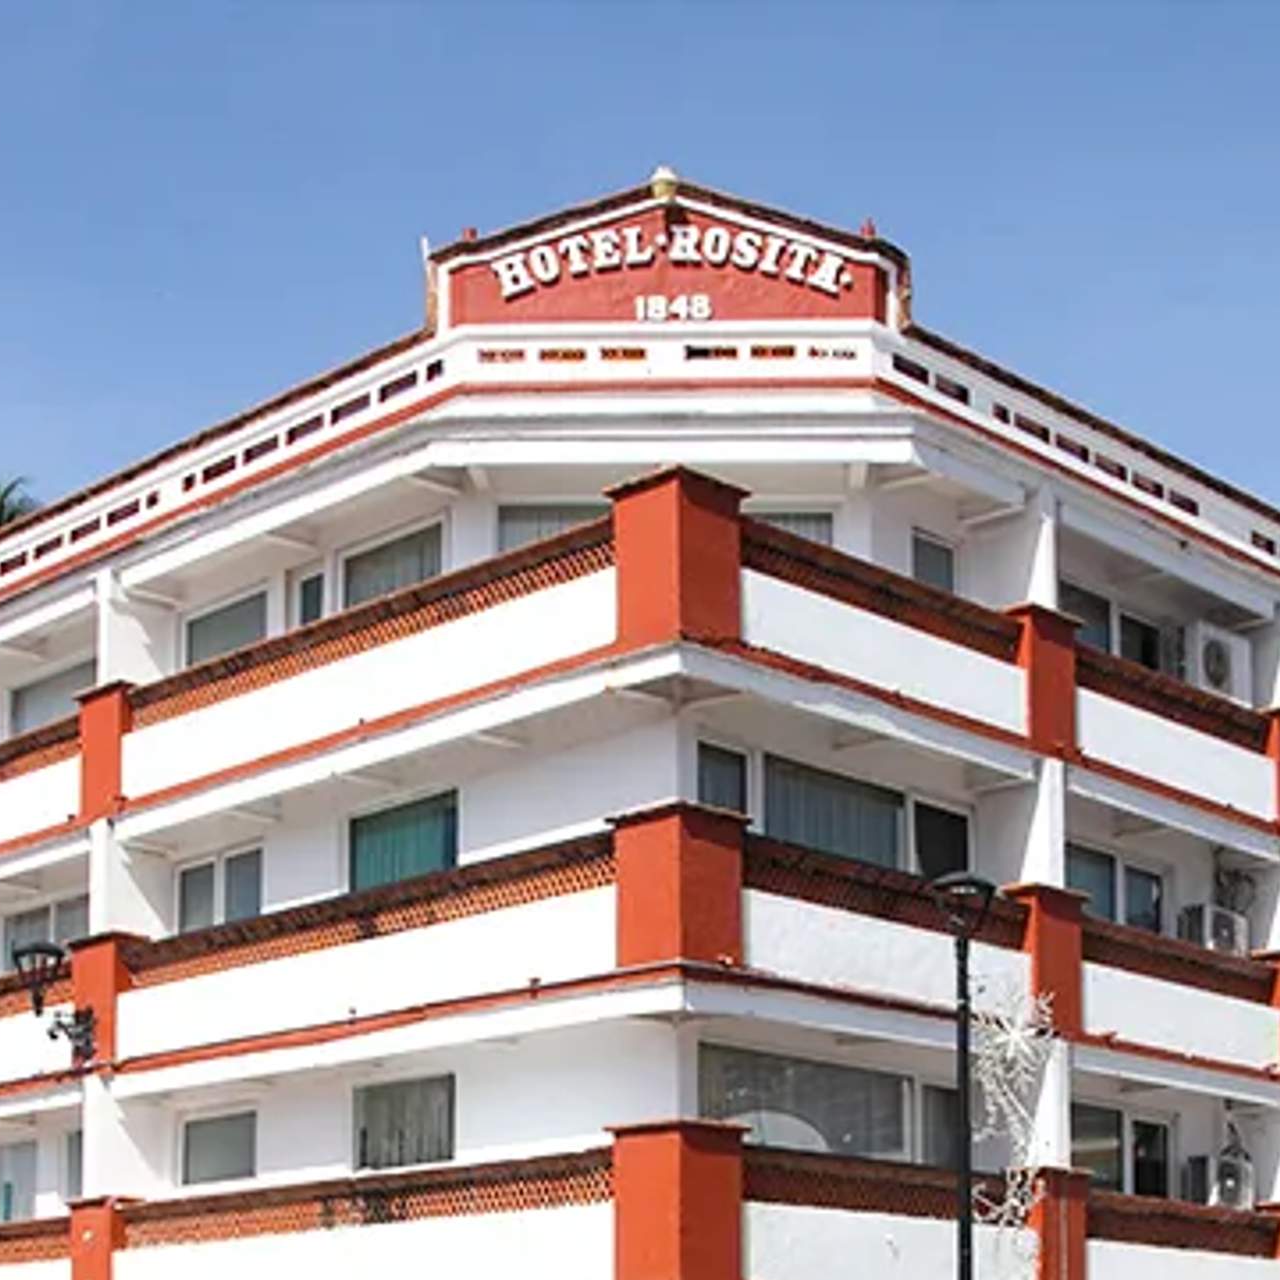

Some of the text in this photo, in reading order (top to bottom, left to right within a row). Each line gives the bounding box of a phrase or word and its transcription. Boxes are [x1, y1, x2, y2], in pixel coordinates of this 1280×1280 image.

[490, 223, 842, 301] HOTEL ROSITA
[634, 295, 713, 322] 1848
